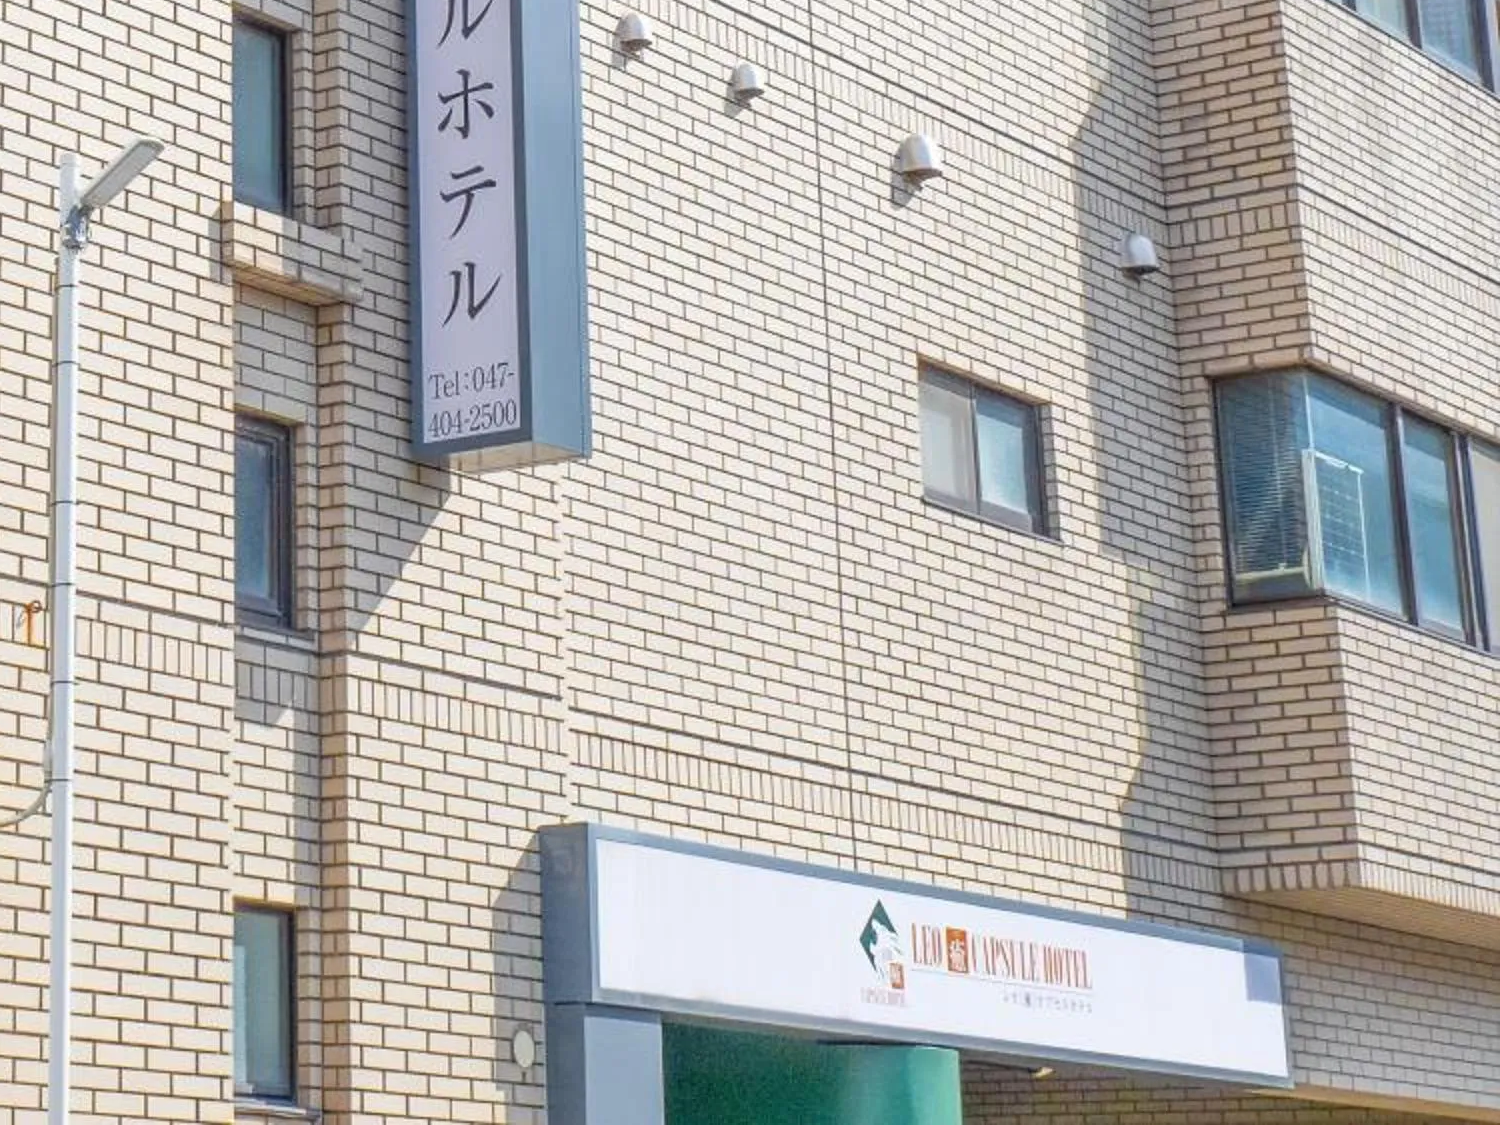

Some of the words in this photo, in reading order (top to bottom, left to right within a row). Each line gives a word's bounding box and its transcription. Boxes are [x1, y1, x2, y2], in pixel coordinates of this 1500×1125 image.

[428, 400, 517, 438] 404-2500
[911, 922, 942, 966] LEO
[971, 932, 1040, 982] CAPSULE
[1043, 944, 1092, 989] HOTEL
